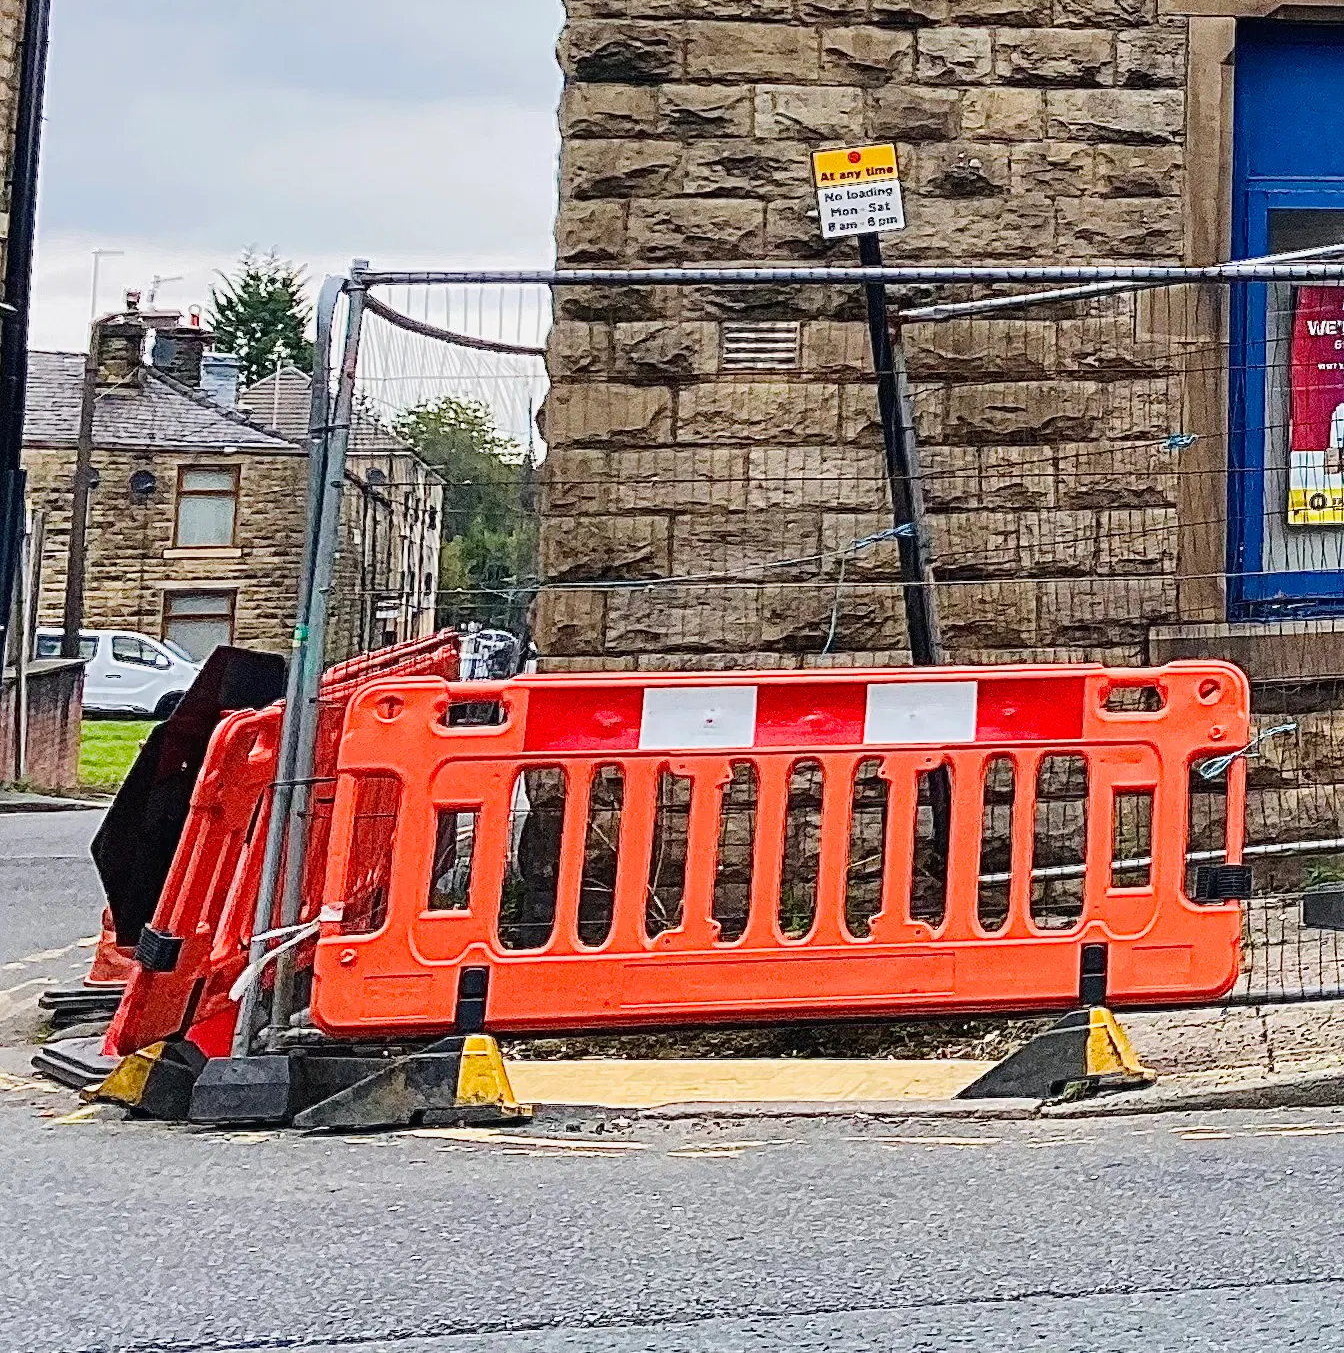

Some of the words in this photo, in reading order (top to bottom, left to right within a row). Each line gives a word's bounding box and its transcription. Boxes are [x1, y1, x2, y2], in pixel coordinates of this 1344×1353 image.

[820, 172, 835, 183] At
[839, 170, 861, 180] any
[865, 166, 893, 177] time
[824, 192, 842, 203] No
[846, 187, 893, 200] loading
[831, 207, 858, 218] Mon
[868, 202, 891, 213] Sat
[878, 217, 898, 229] pm
